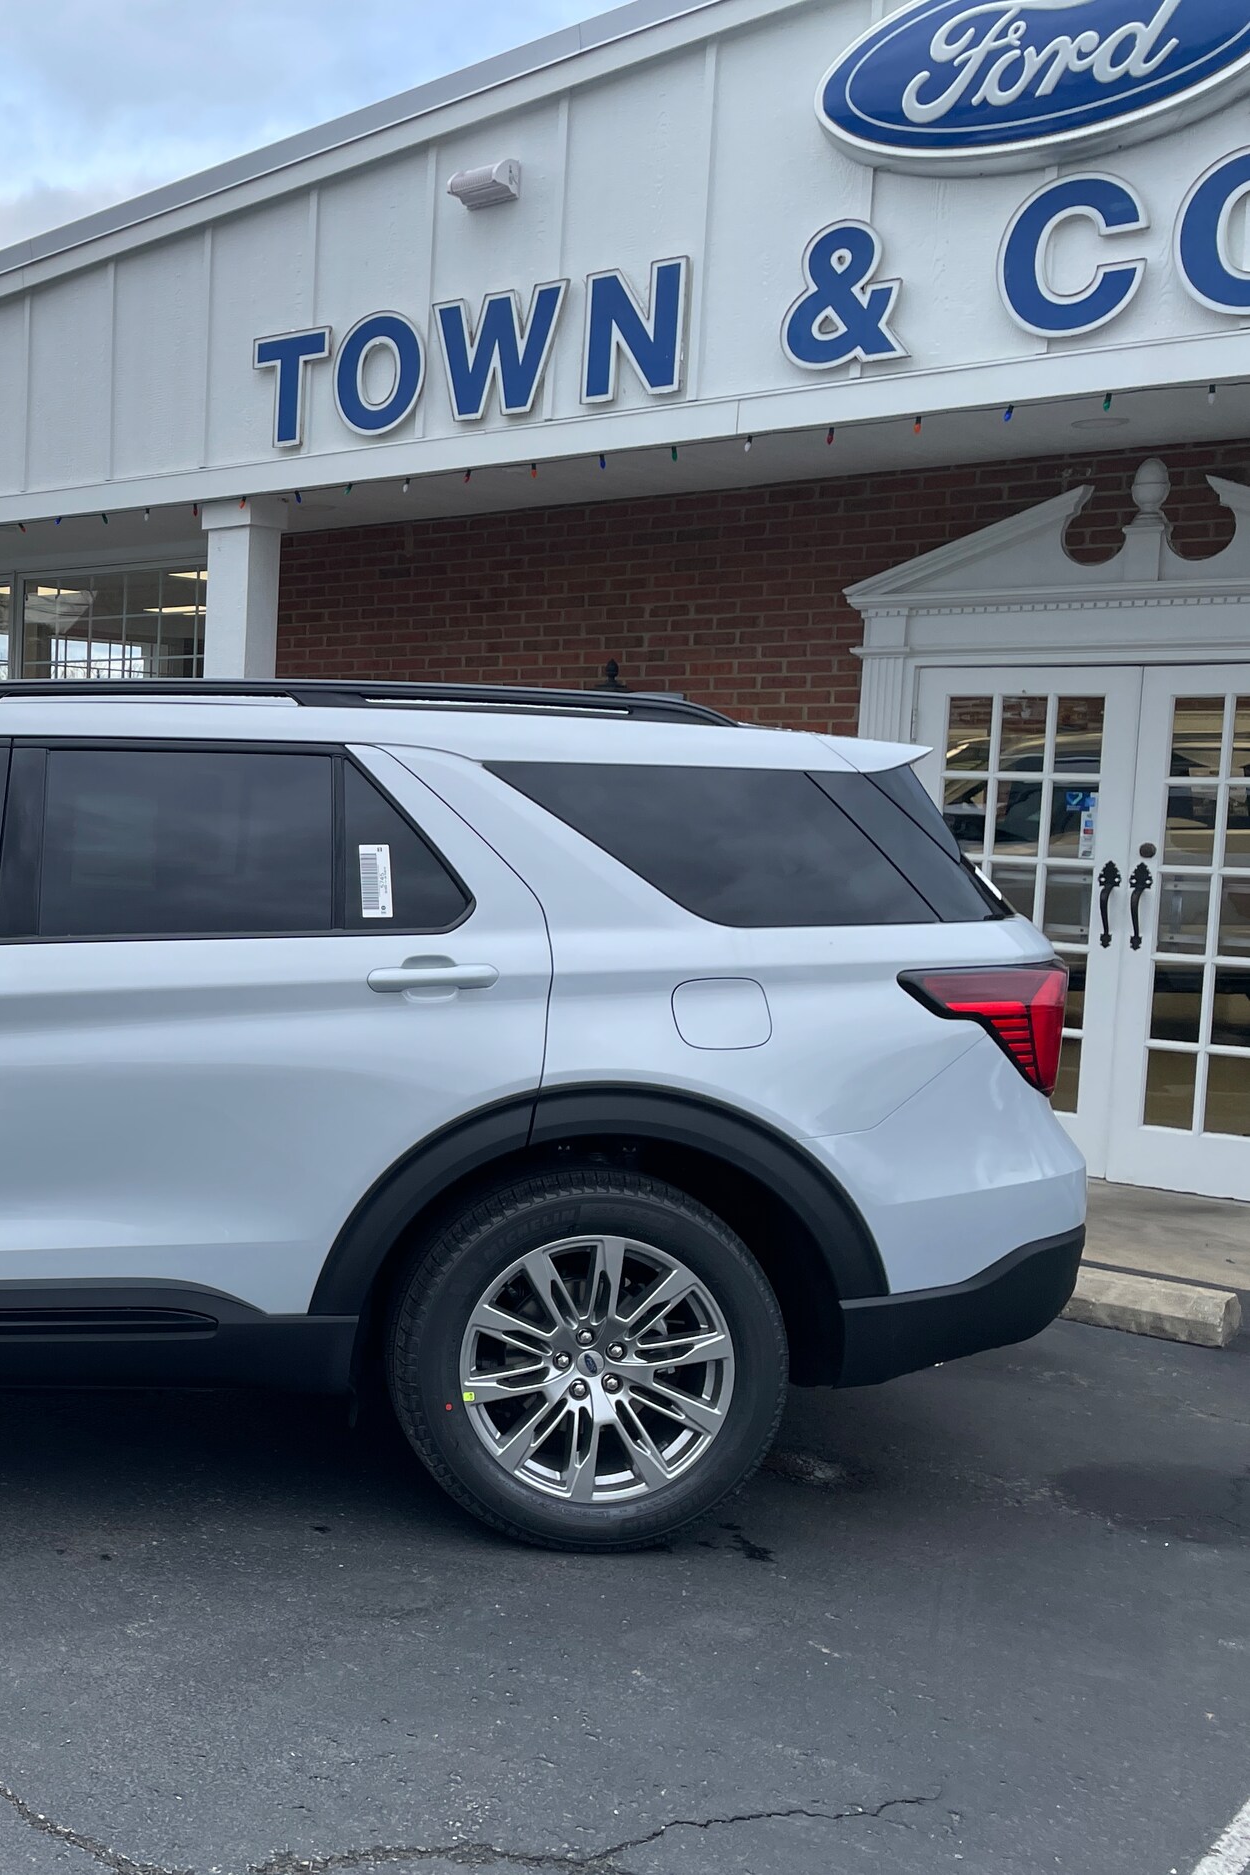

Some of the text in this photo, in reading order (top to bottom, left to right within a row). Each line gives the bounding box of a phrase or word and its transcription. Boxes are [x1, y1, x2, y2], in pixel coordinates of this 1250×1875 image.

[902, 0, 1180, 124] Ford
[254, 256, 690, 449] TOWN
[781, 218, 910, 370] &
